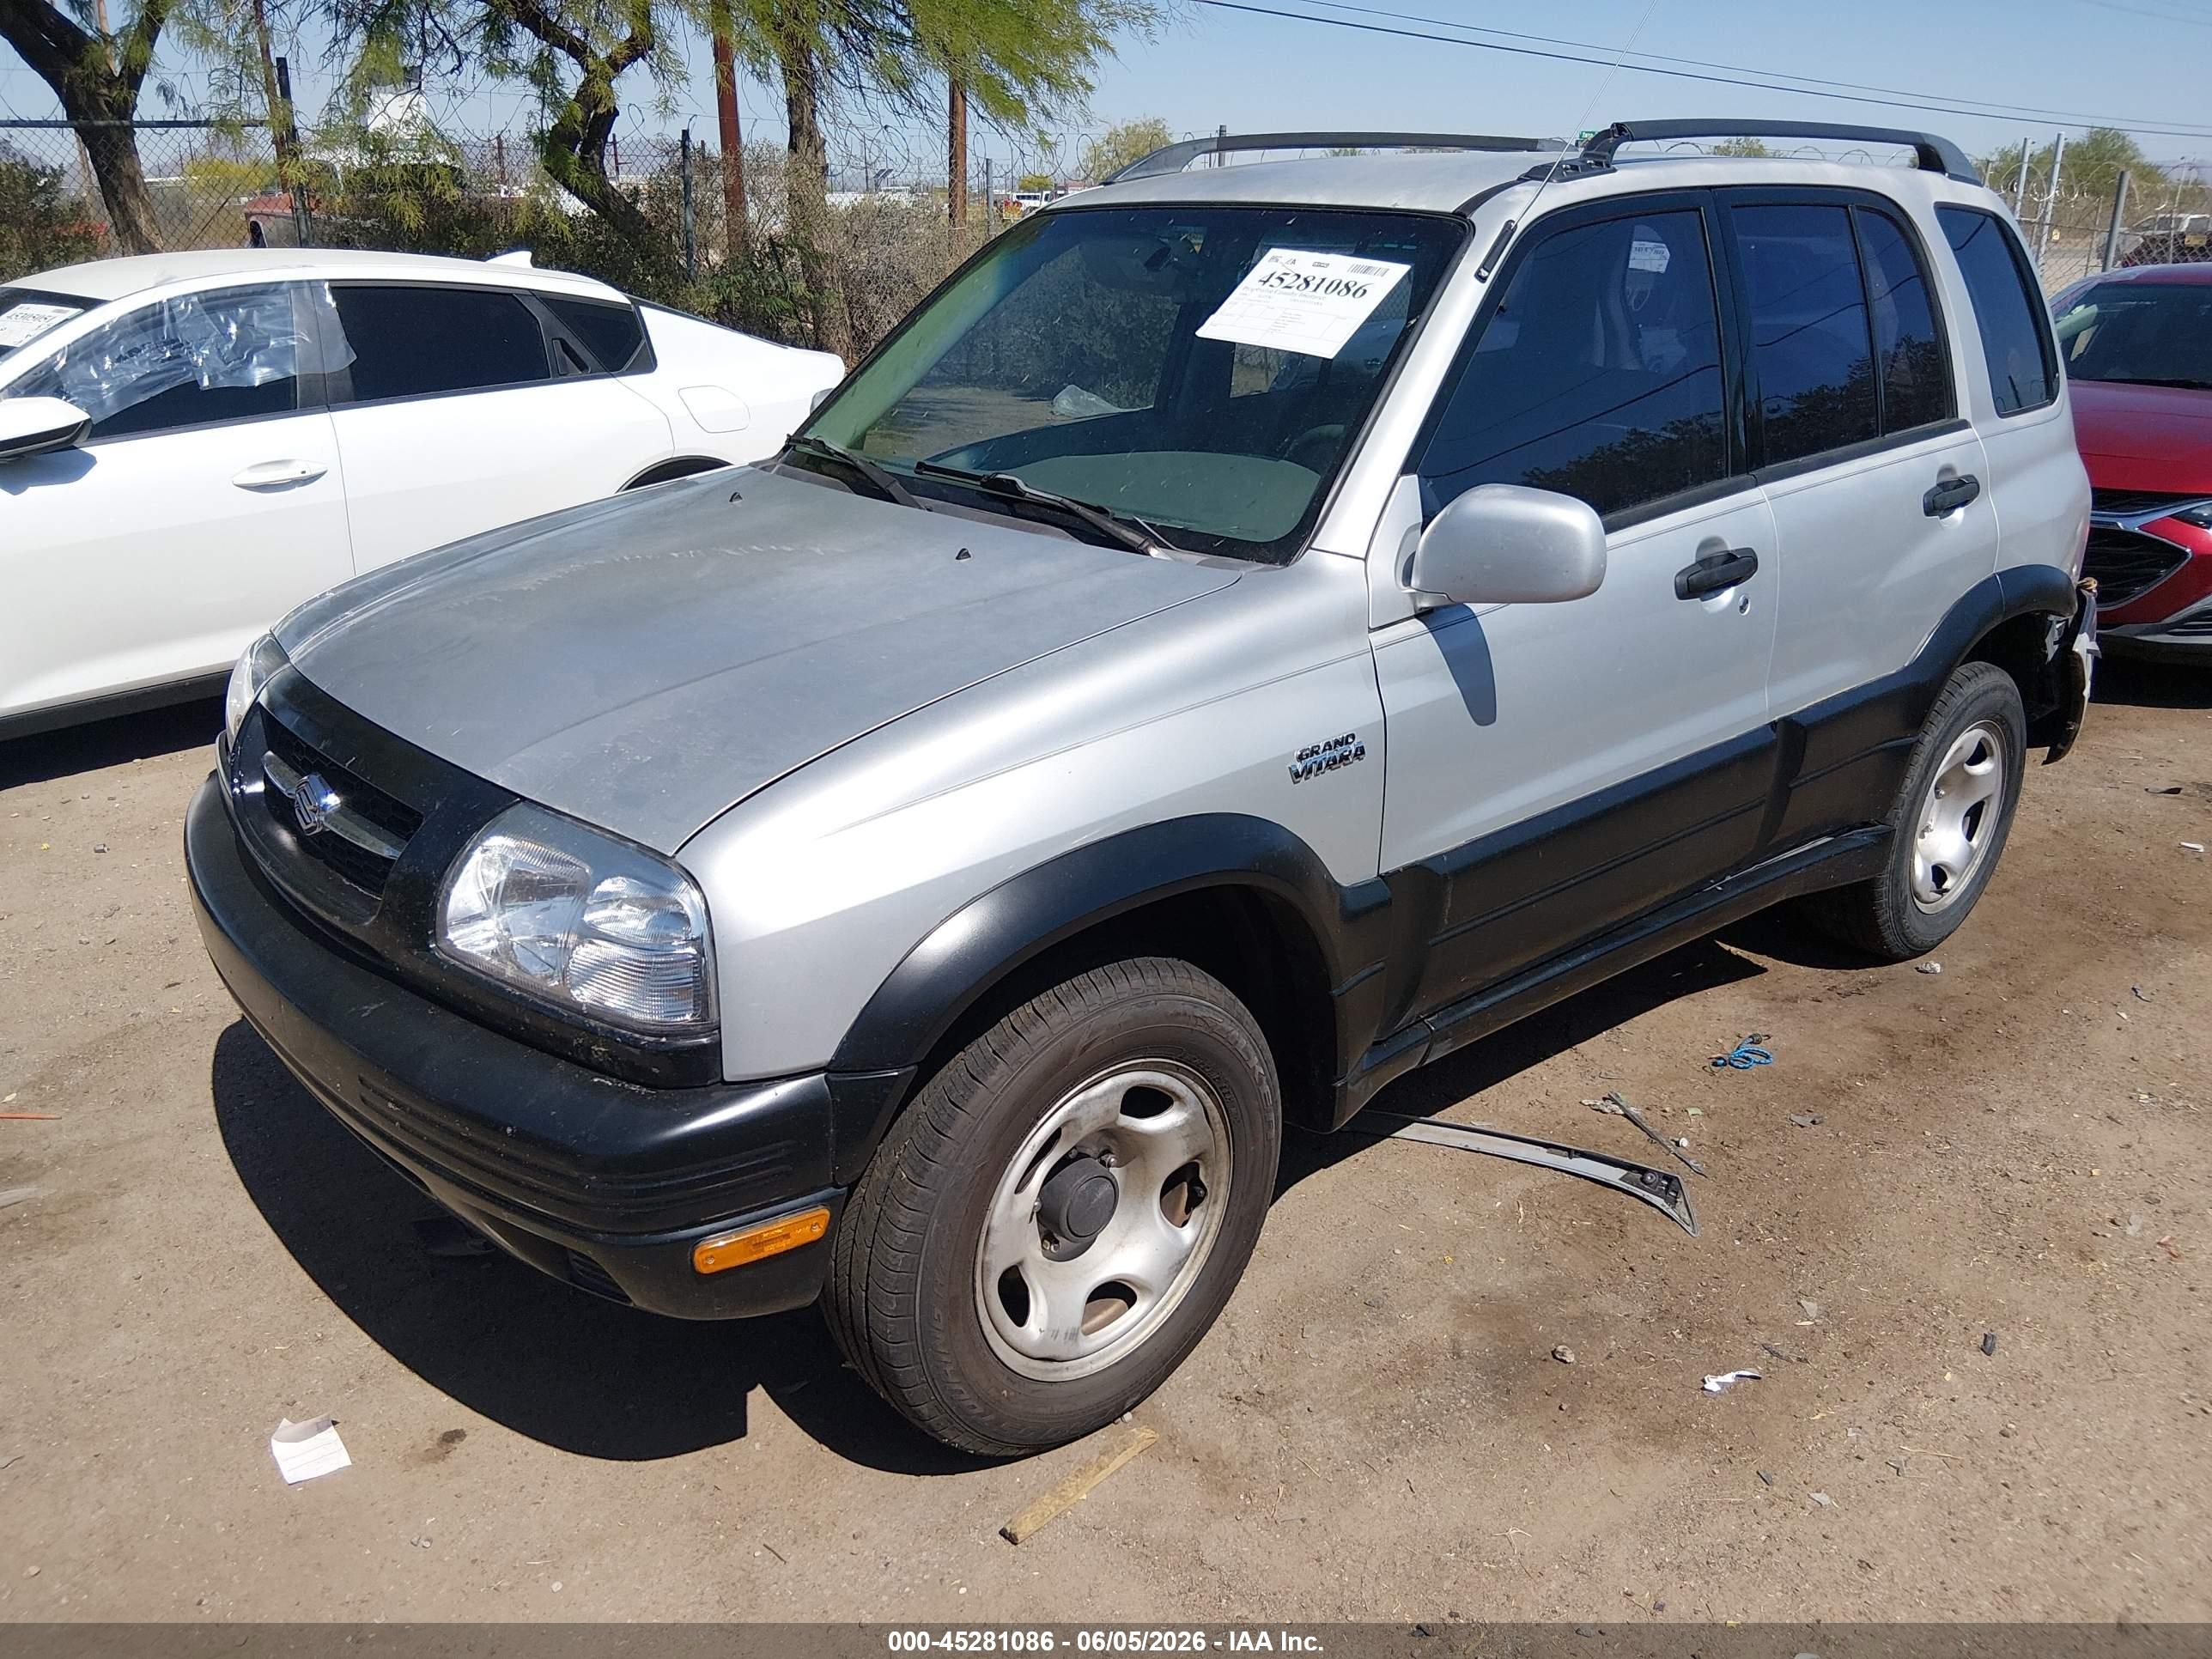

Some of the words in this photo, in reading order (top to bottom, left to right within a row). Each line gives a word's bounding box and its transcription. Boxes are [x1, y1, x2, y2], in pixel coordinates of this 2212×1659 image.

[1258, 270, 1373, 299] 45281086
[1297, 732, 1356, 762] GRAND
[1288, 742, 1365, 785] VITARA
